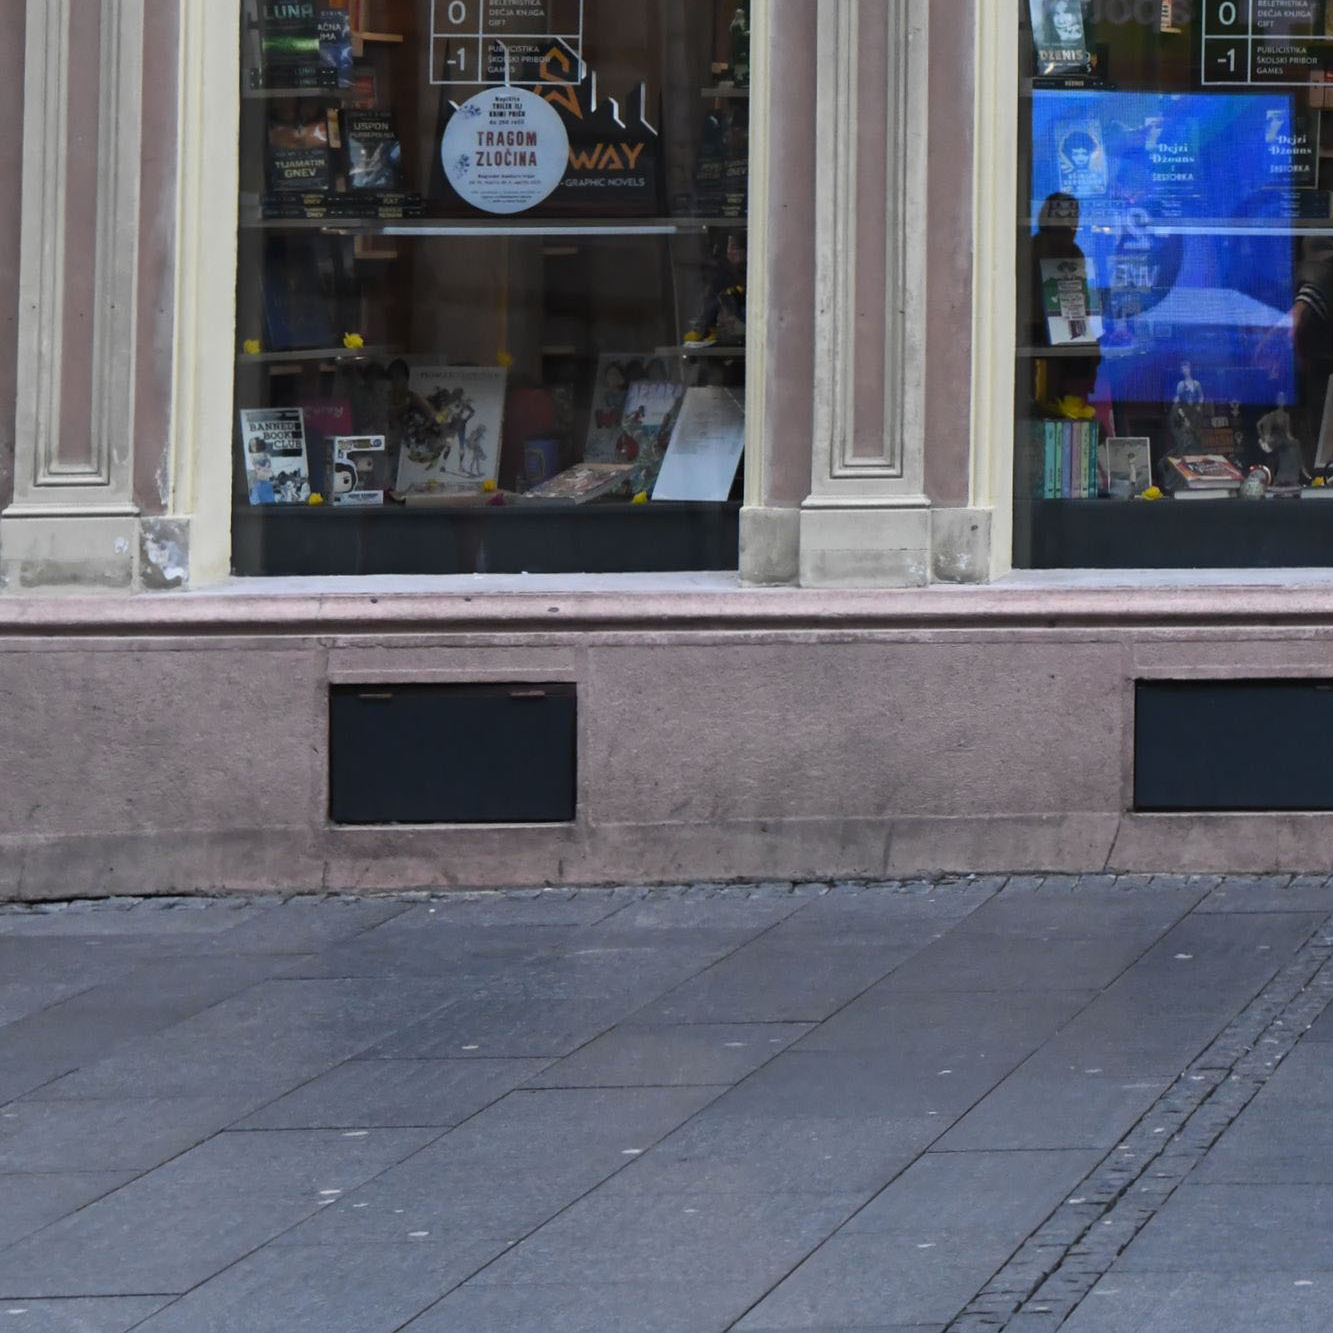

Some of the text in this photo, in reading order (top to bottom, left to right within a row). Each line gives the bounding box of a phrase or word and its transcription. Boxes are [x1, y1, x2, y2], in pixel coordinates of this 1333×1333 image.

[1257, 0, 1308, 7] BELETRISTIKA
[448, 0, 466, 24] 0
[1218, 1, 1236, 26] 0
[489, 19, 506, 27] GIFT
[1257, 20, 1274, 28] GIFT
[1257, 46, 1307, 54] PUBLICISTIKA
[1217, 48, 1236, 72] -1
[1256, 67, 1284, 75] GAMES
[353, 122, 390, 131] USPON
[477, 131, 538, 147] TRAGOM
[1275, 134, 1308, 146] Dejzi
[1157, 143, 1189, 154] Dejzi
[476, 148, 538, 167] ZLOČINA
[284, 169, 317, 178] GNEV
[566, 177, 646, 187] GRAPHIC NOVELS
[250, 422, 295, 431] BANNED
[272, 440, 303, 449] CLUB
